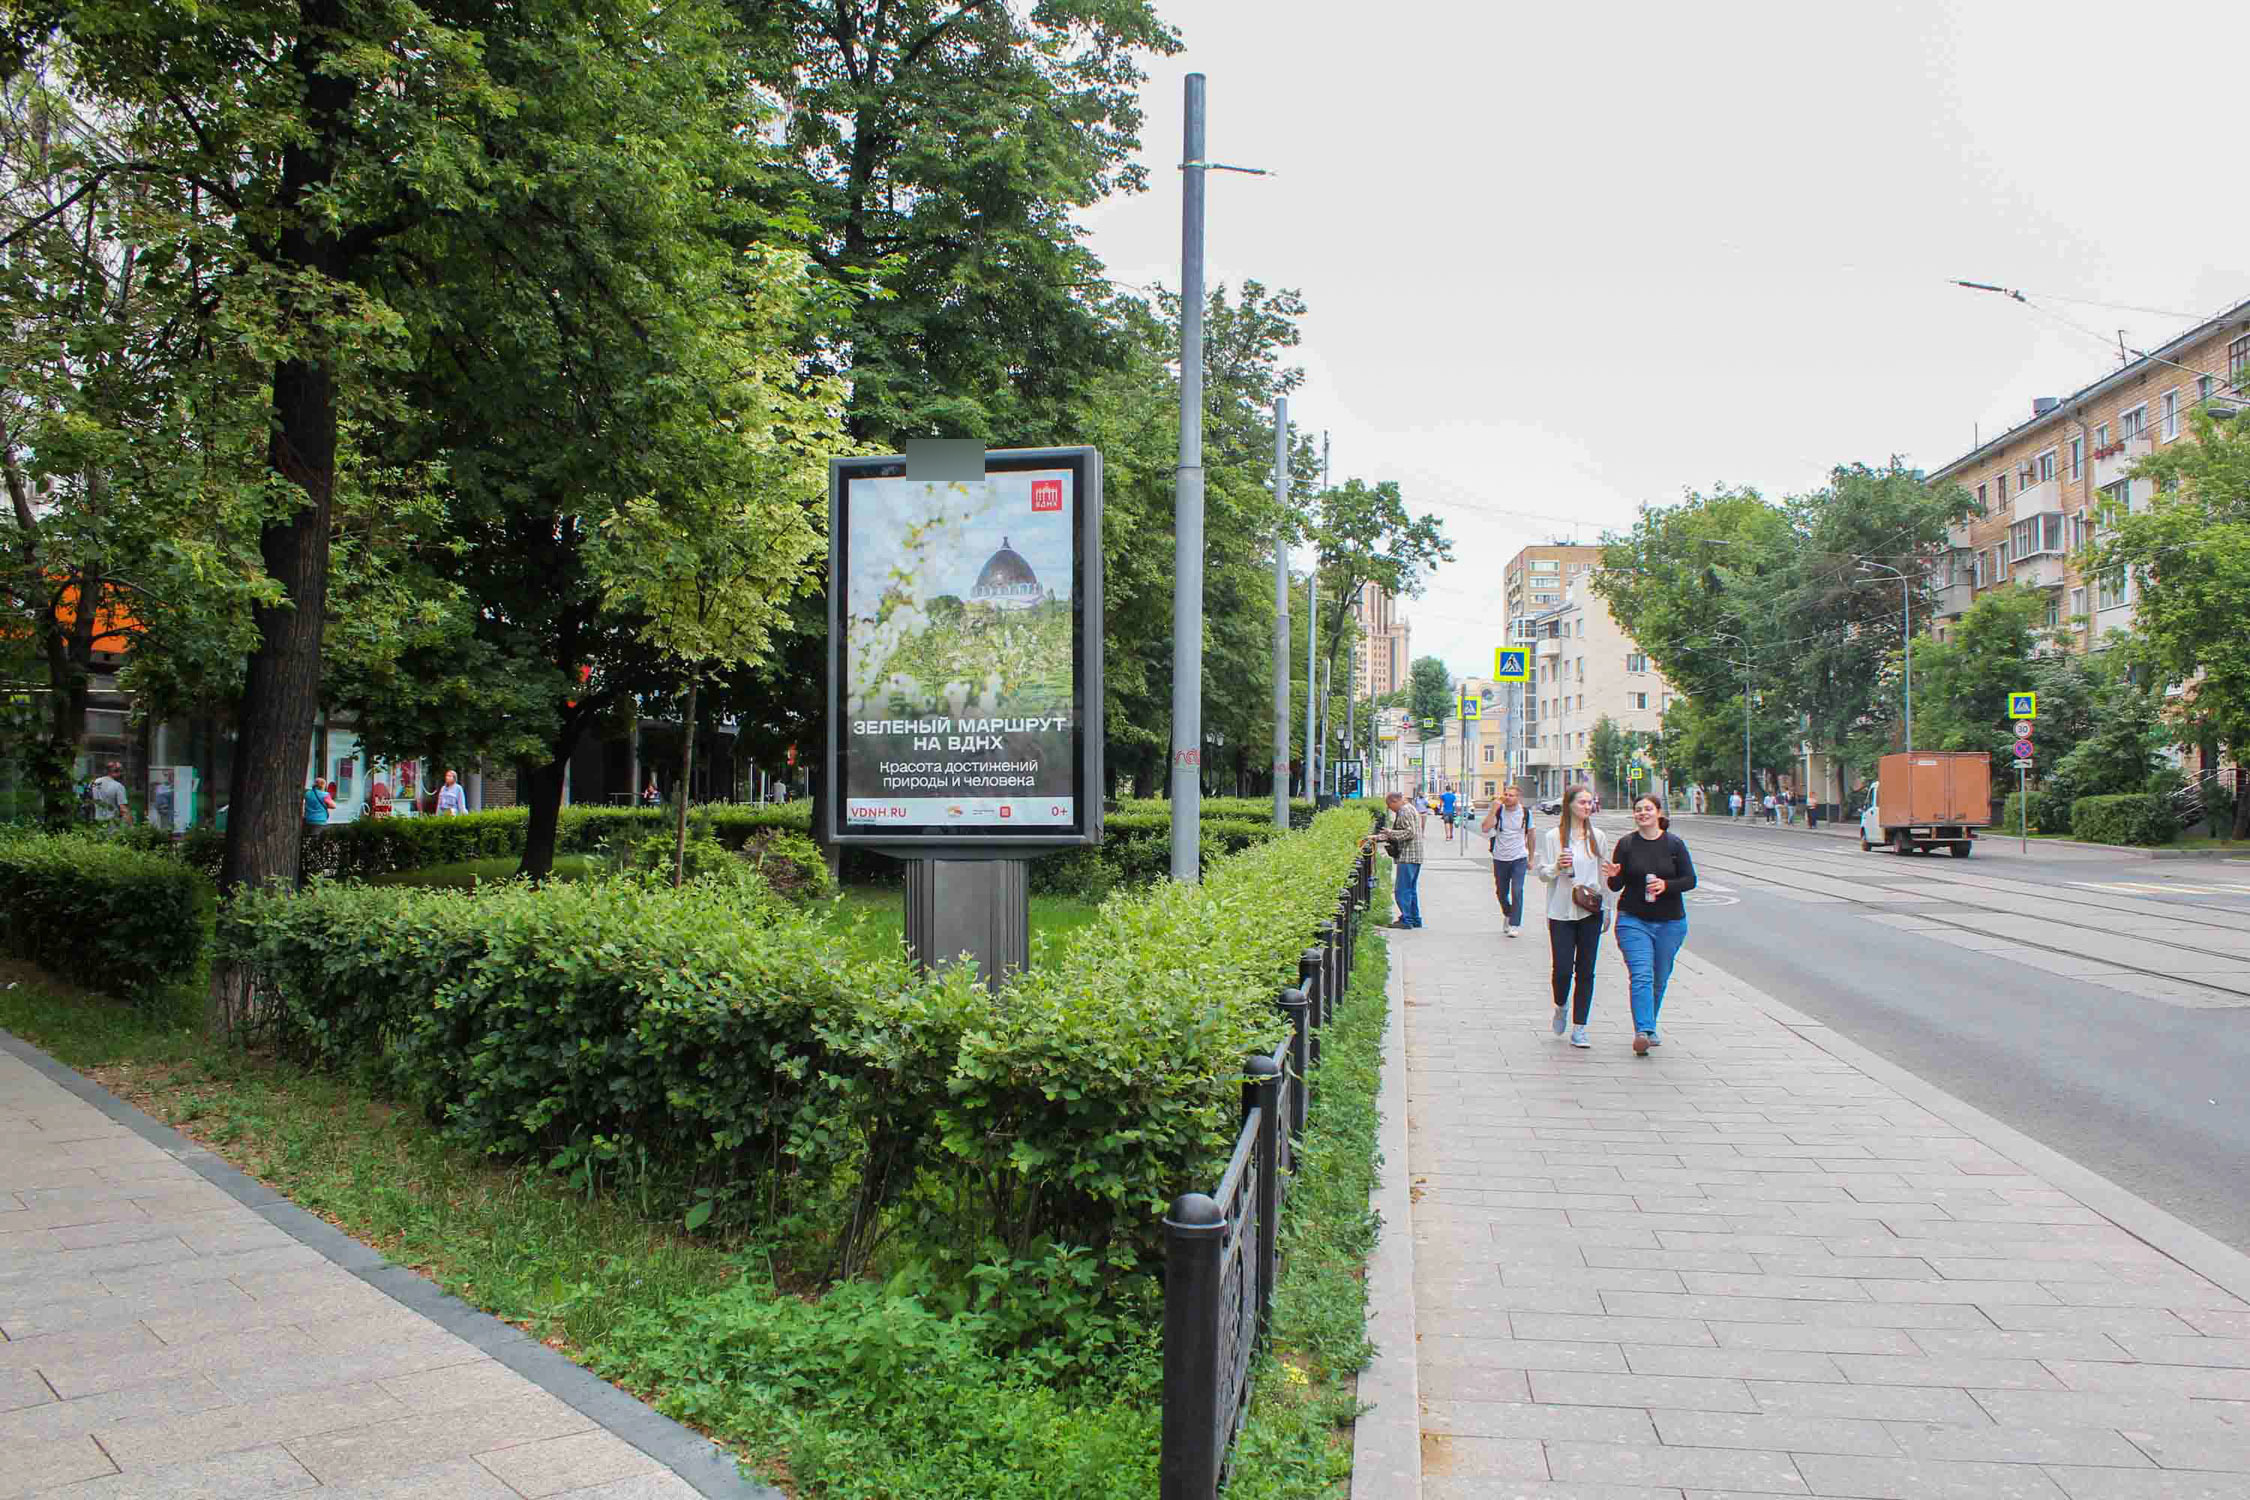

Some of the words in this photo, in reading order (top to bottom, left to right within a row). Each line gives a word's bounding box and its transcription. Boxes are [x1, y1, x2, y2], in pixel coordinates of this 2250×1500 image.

[853, 717, 951, 735] ЗЕЛЕНЫЙ
[957, 717, 1067, 733] МАРШРУТ
[2017, 725, 2029, 733] 30
[914, 737, 941, 750] НА
[948, 736, 1003, 752] ВДНХ
[879, 762, 942, 775] Красота
[944, 759, 1038, 774] достижений
[883, 776, 948, 789] природы
[952, 777, 960, 787] и
[963, 775, 1035, 788] человека
[851, 807, 907, 818] VDNH.RU
[1051, 806, 1068, 816] 0+
